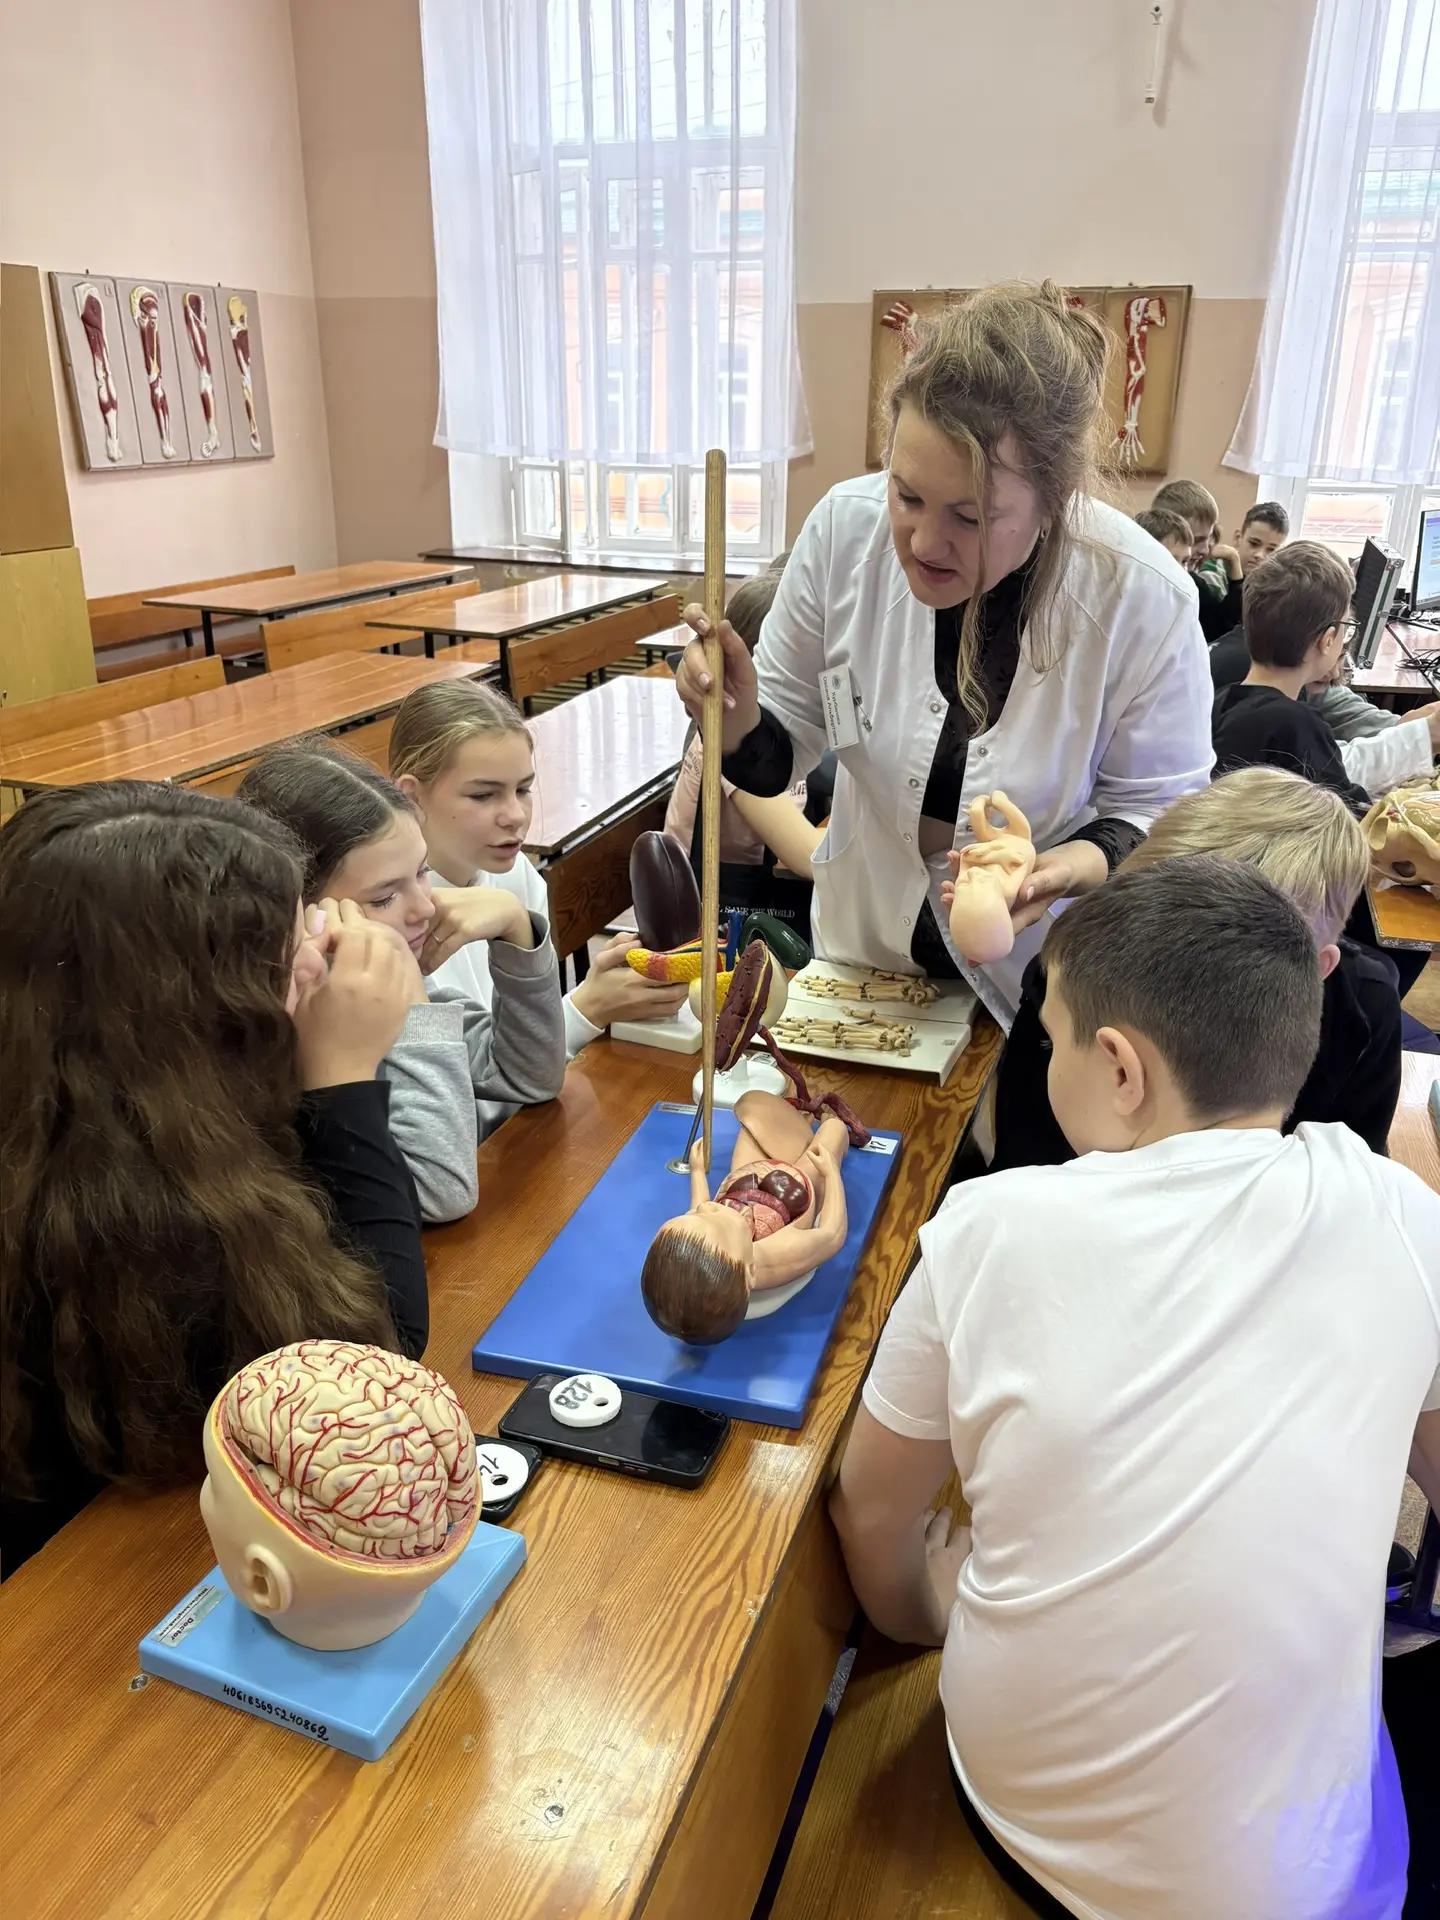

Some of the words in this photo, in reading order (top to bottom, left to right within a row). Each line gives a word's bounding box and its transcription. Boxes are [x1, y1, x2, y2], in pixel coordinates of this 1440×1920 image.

[724, 905, 749, 916] SAVE
[766, 908, 796, 918] WORLD
[869, 1140, 888, 1151] 17
[554, 1377, 594, 1410] 128
[171, 1617, 195, 1641] Doctor
